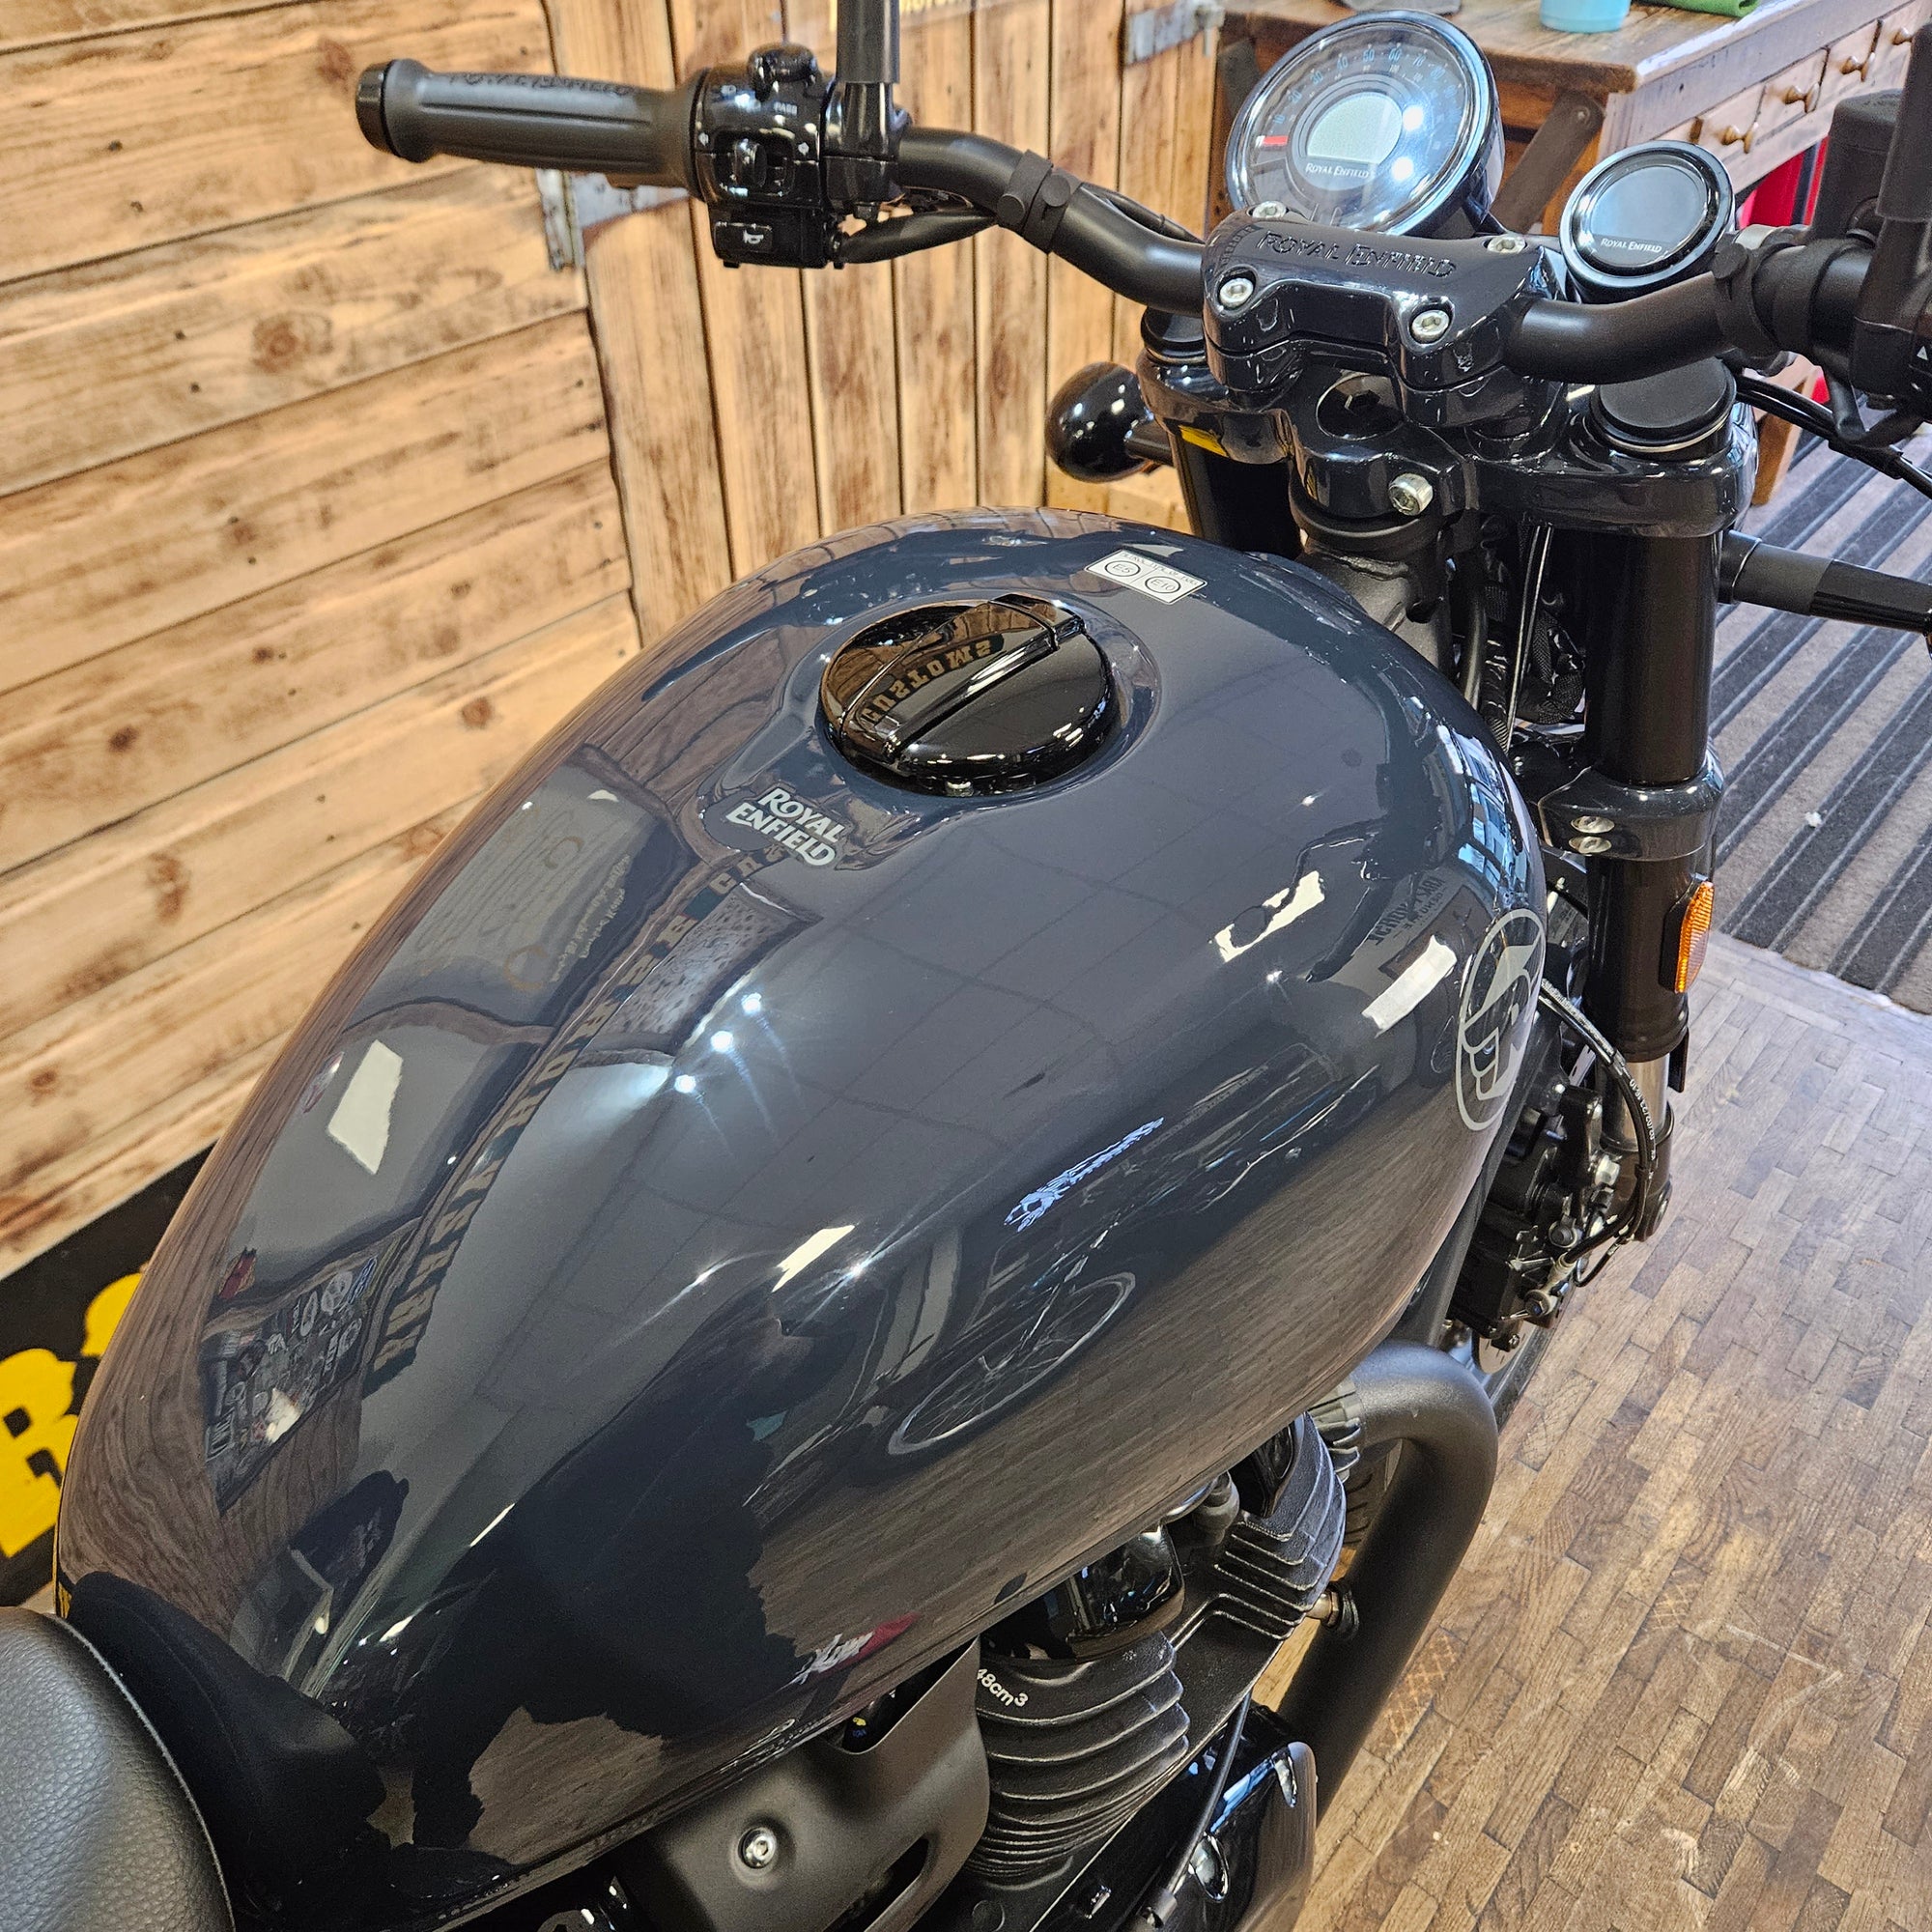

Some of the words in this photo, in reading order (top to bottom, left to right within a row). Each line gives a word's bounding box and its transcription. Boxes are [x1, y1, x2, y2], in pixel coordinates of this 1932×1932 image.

[1305, 162, 1332, 174] ROYAL
[1333, 165, 1370, 179] ENFIELD
[1257, 231, 1341, 260] ROYAL
[1345, 242, 1457, 278] ENFIELD
[1601, 238, 1628, 249] ROYAL
[1628, 241, 1662, 253] ENFIELD
[1151, 578, 1177, 591] E10
[757, 787, 845, 843] ROYAL
[725, 802, 836, 866] ENFIELD
